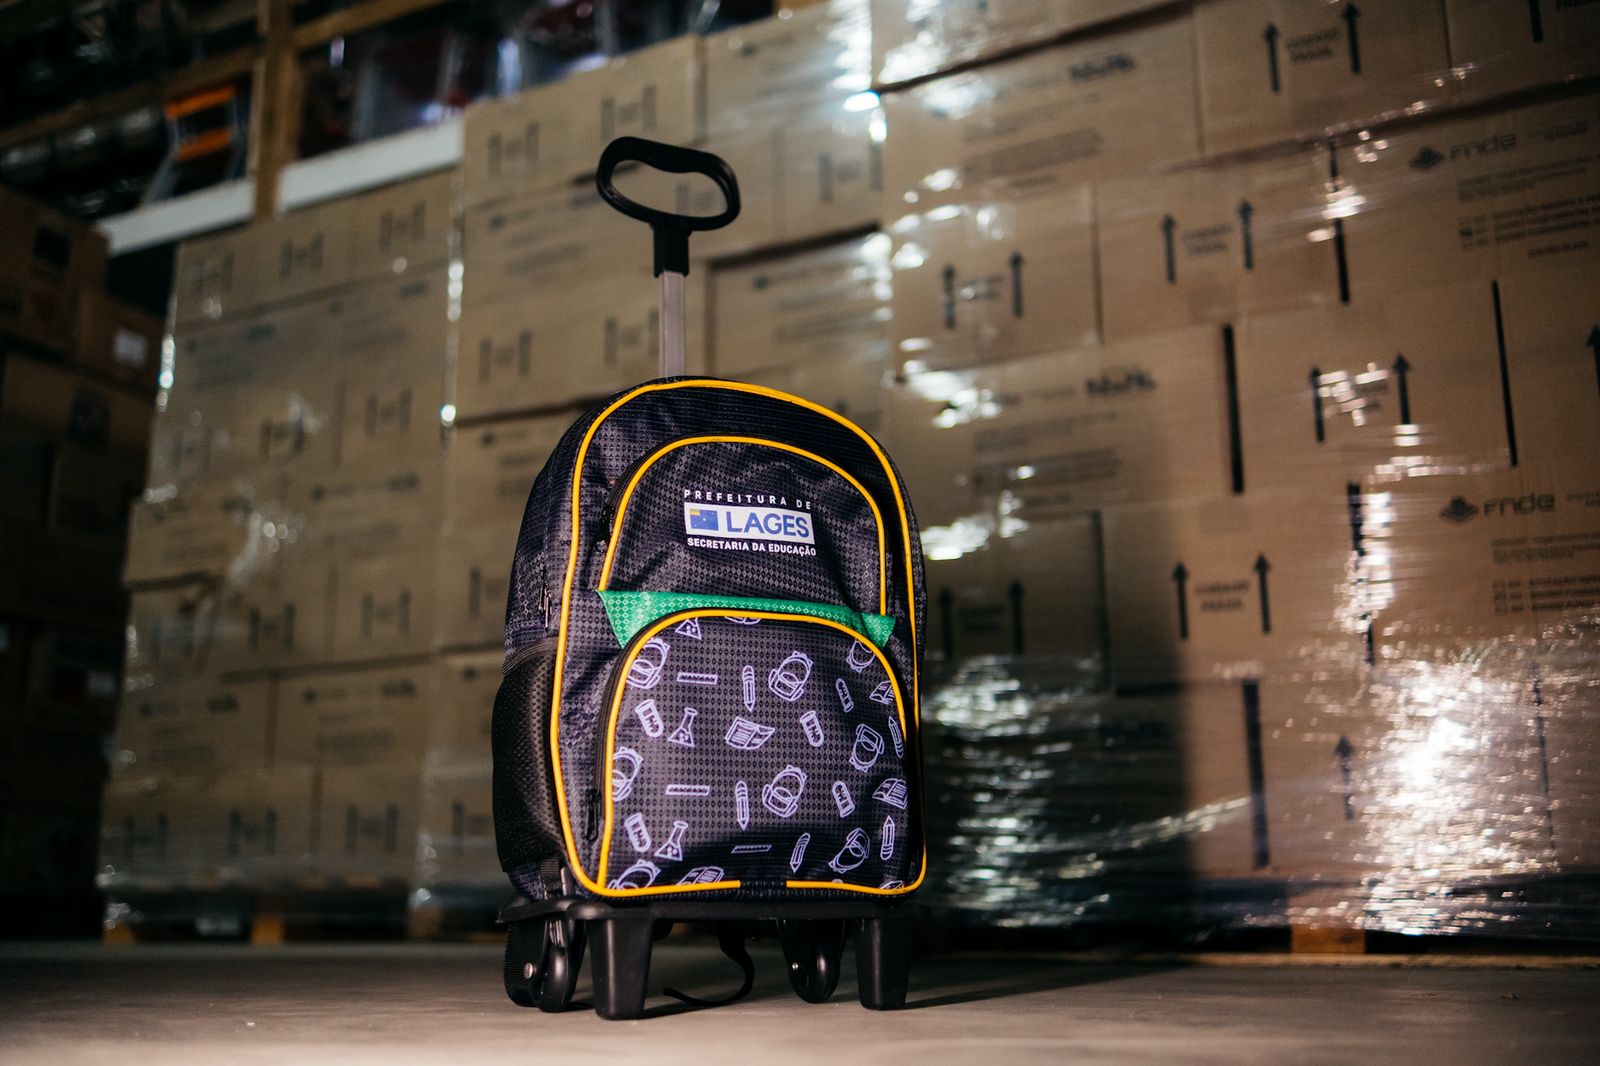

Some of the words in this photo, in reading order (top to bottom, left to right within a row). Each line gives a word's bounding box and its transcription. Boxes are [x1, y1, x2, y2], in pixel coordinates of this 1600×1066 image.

[684, 489, 787, 505] PREFEITURA
[796, 500, 811, 509] DE
[726, 511, 810, 538] LAGES
[687, 537, 750, 550] SECRETARIA
[752, 543, 766, 552] DA
[768, 544, 817, 557] EDUCAÇÃO
